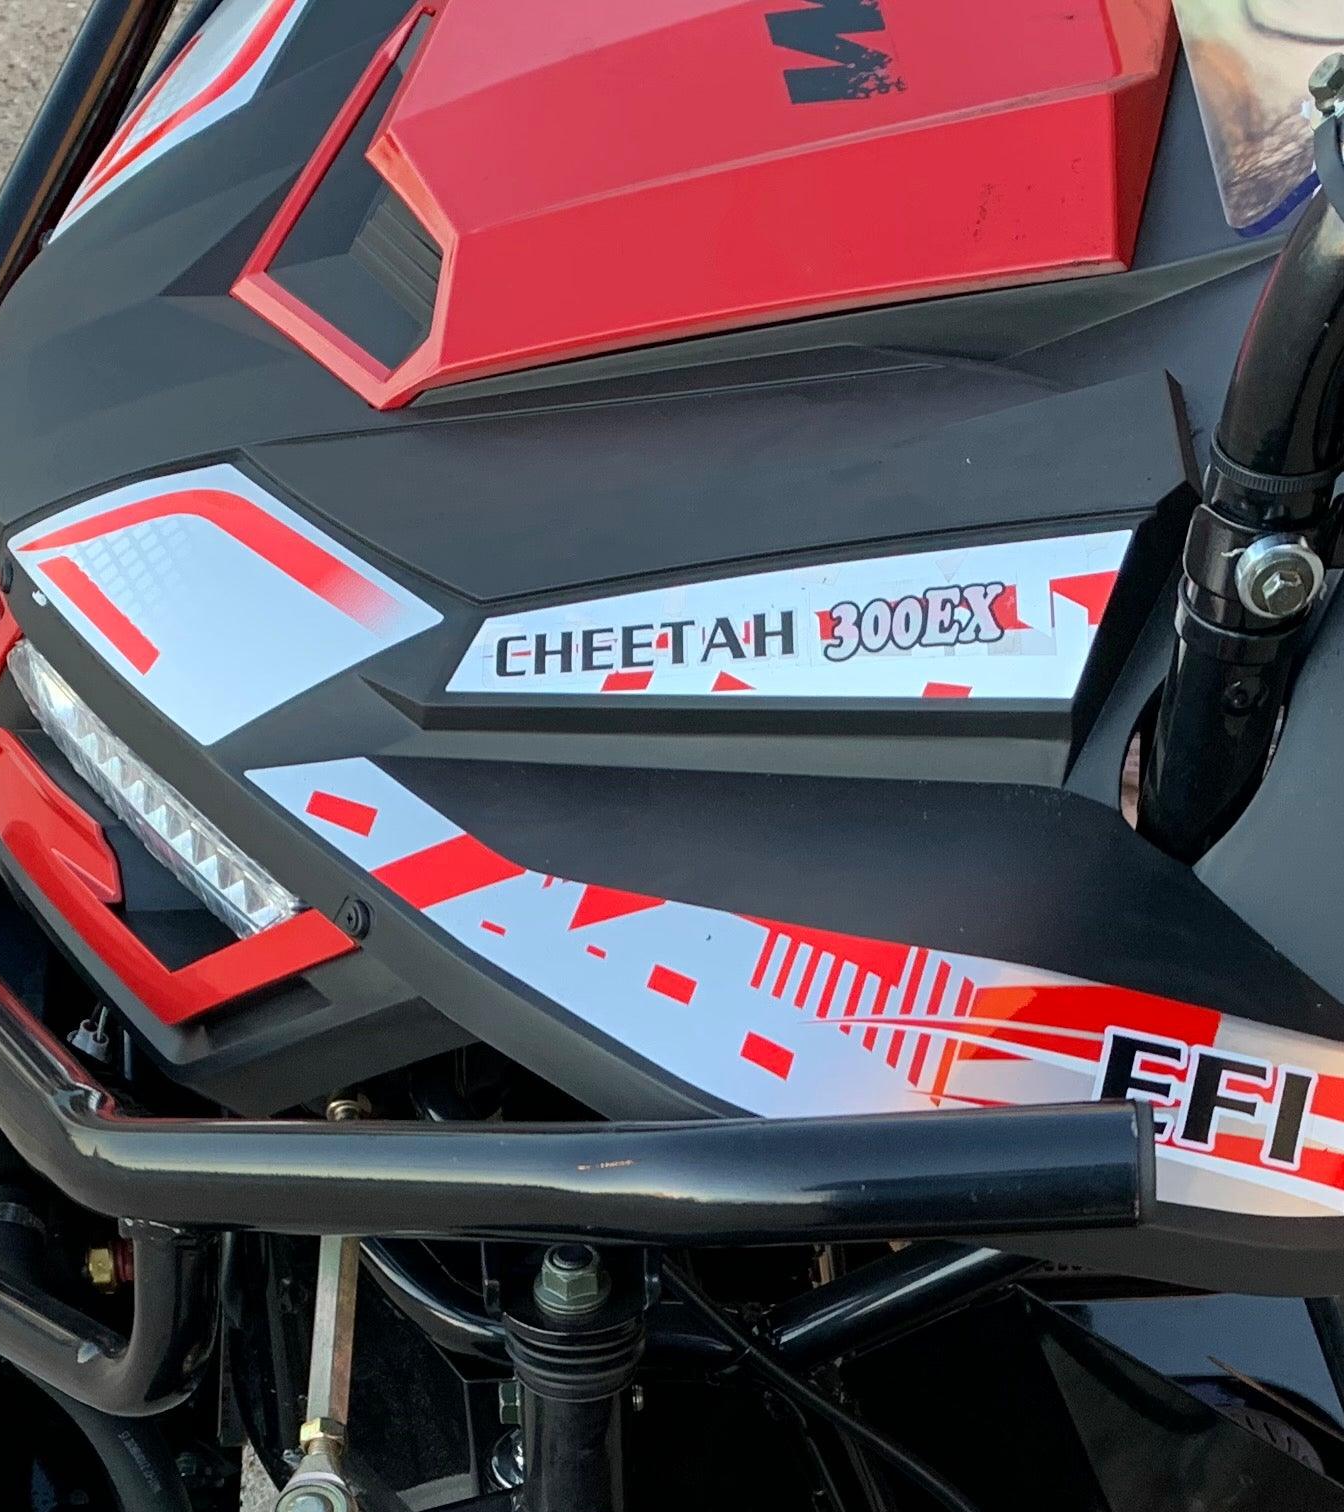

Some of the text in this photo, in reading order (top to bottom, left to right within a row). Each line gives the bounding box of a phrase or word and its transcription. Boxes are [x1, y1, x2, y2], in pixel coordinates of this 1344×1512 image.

[496, 581, 1005, 677] CHEETAH 300EX
[1096, 1028, 1316, 1167] EFI
